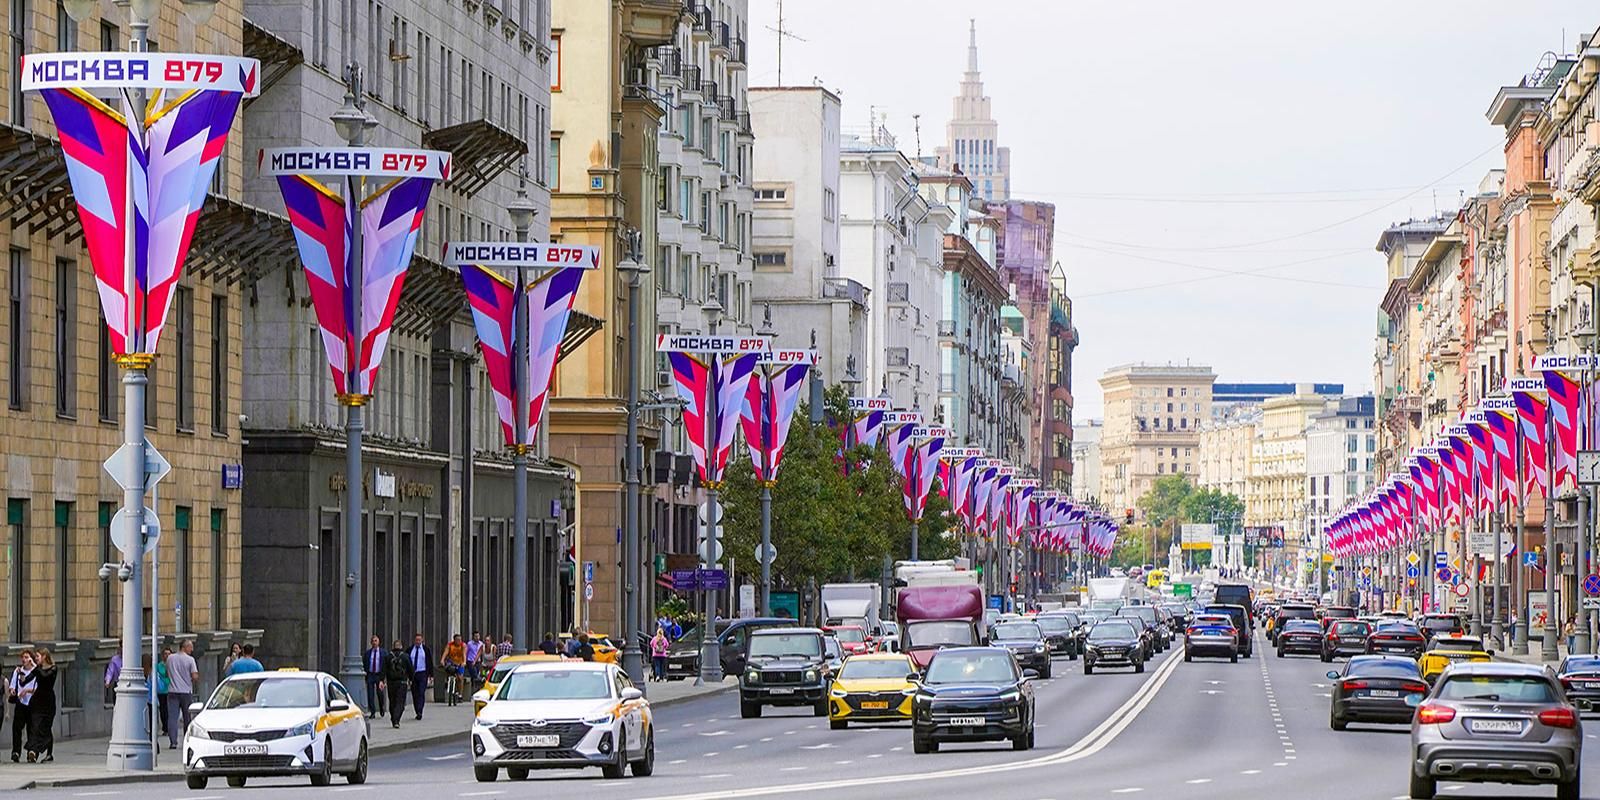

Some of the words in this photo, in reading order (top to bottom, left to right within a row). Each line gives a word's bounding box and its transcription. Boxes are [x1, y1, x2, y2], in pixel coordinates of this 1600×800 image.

[32, 59, 149, 83] МОСКВА
[164, 60, 223, 83] 879
[271, 152, 370, 170] МОСКВА
[382, 153, 427, 172] 879
[455, 246, 538, 261] МОСКВА
[546, 247, 583, 263] 879
[670, 338, 734, 350] МОСКВА
[739, 339, 764, 351] 879
[779, 351, 804, 361] 879
[868, 400, 887, 408] 879
